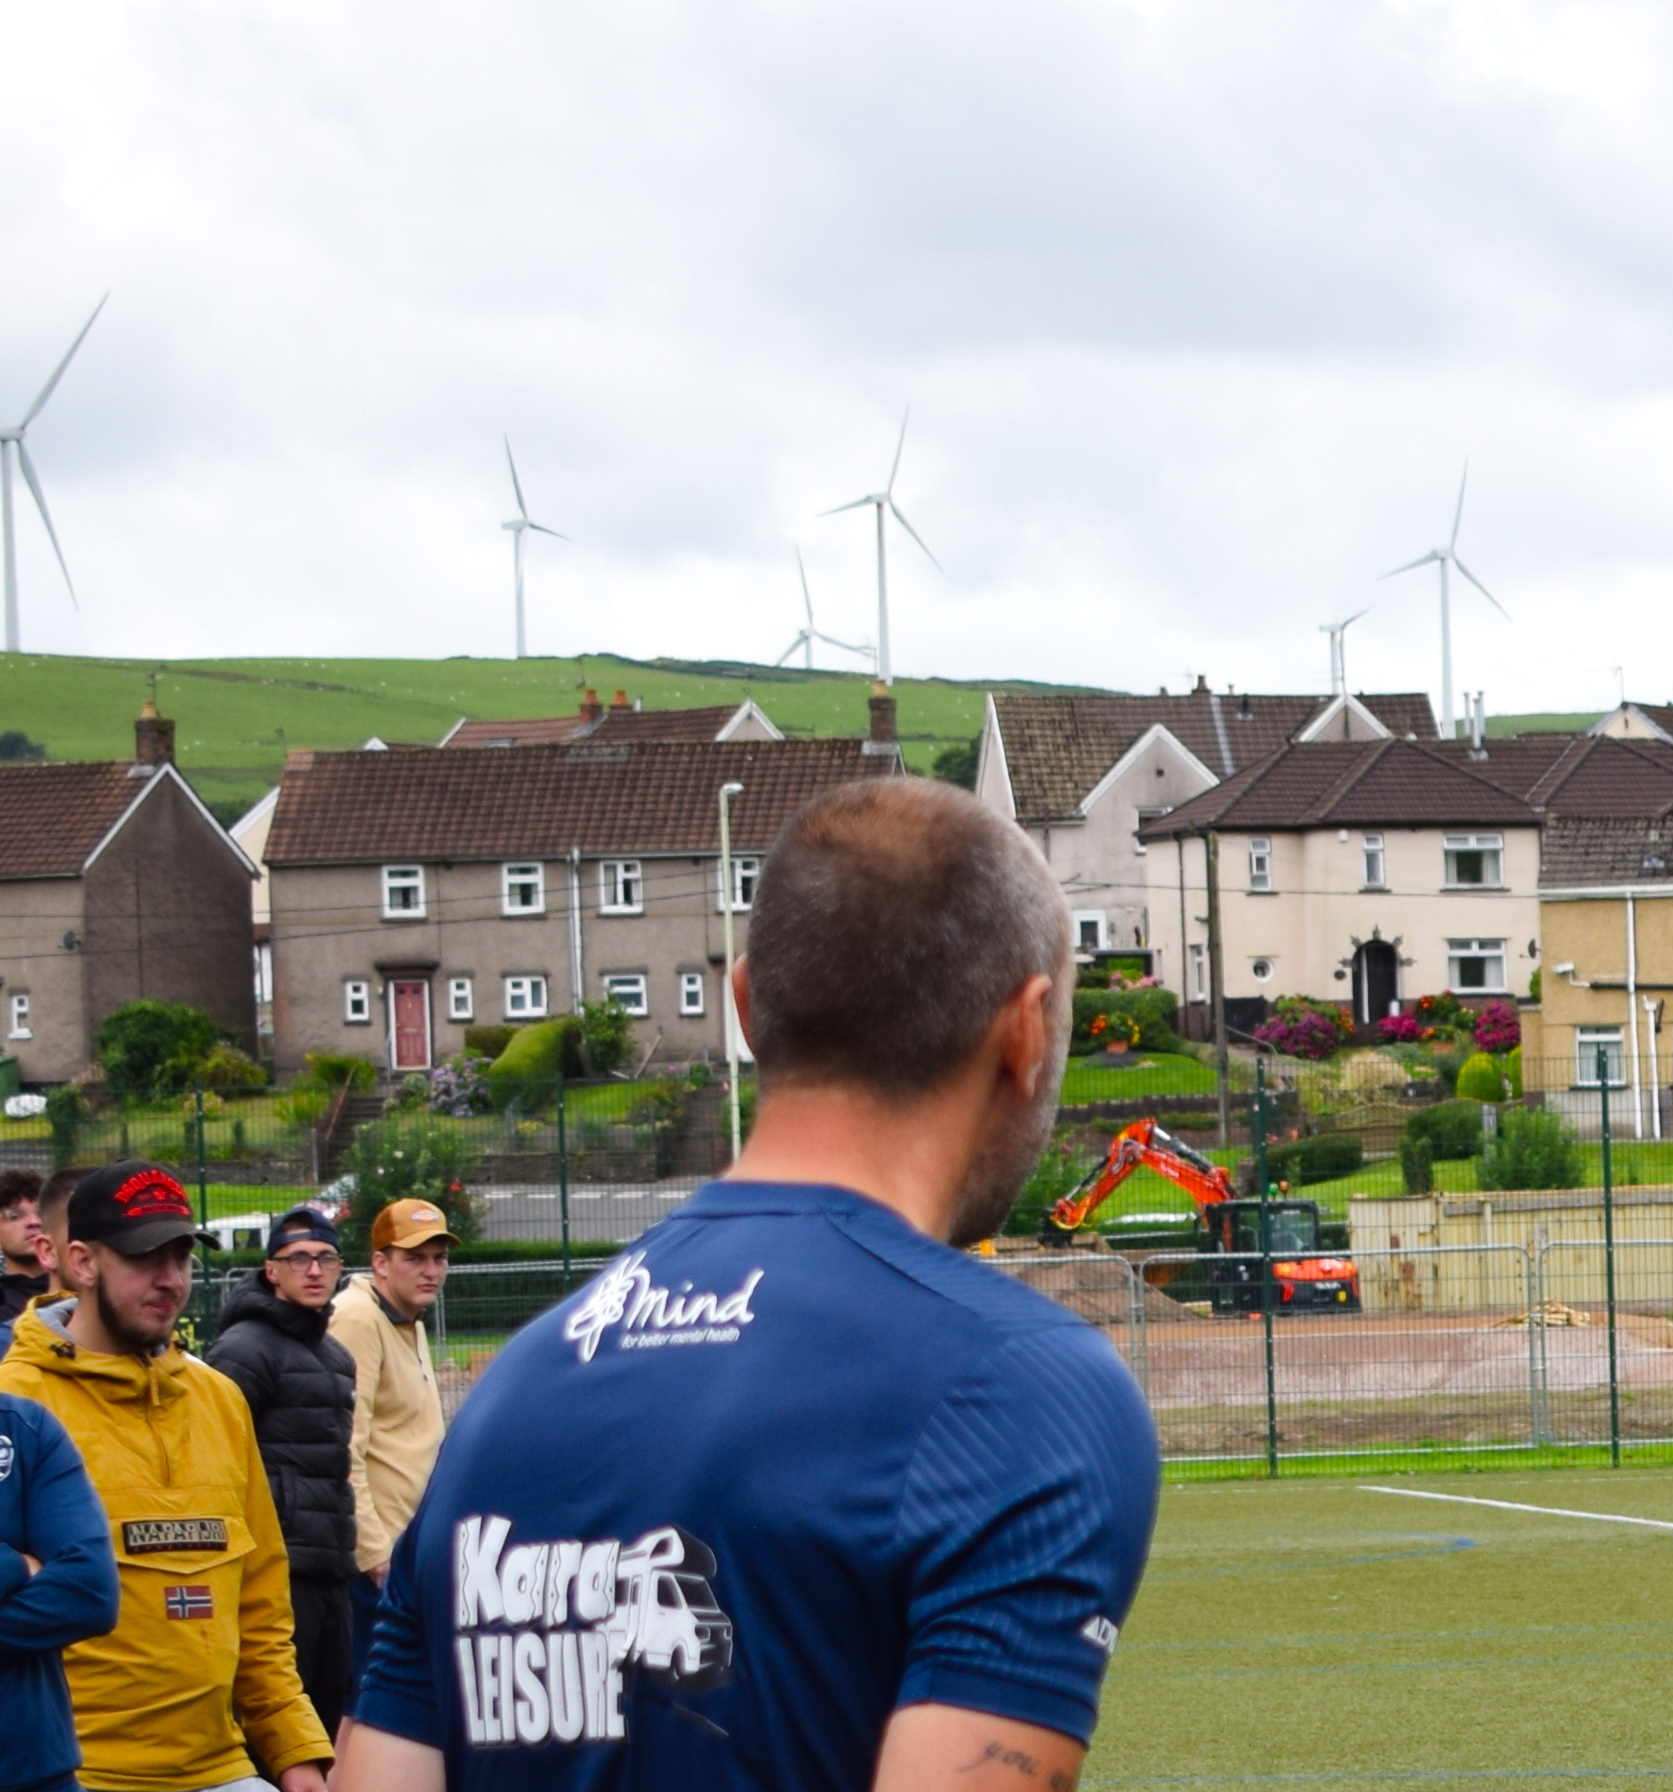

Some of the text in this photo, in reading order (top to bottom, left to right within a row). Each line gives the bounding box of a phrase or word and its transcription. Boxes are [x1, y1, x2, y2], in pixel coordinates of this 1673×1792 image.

[624, 1266, 765, 1329] mind
[706, 1326, 741, 1341] health
[456, 1514, 621, 1628] Kara
[457, 1631, 626, 1743] LEISURE
